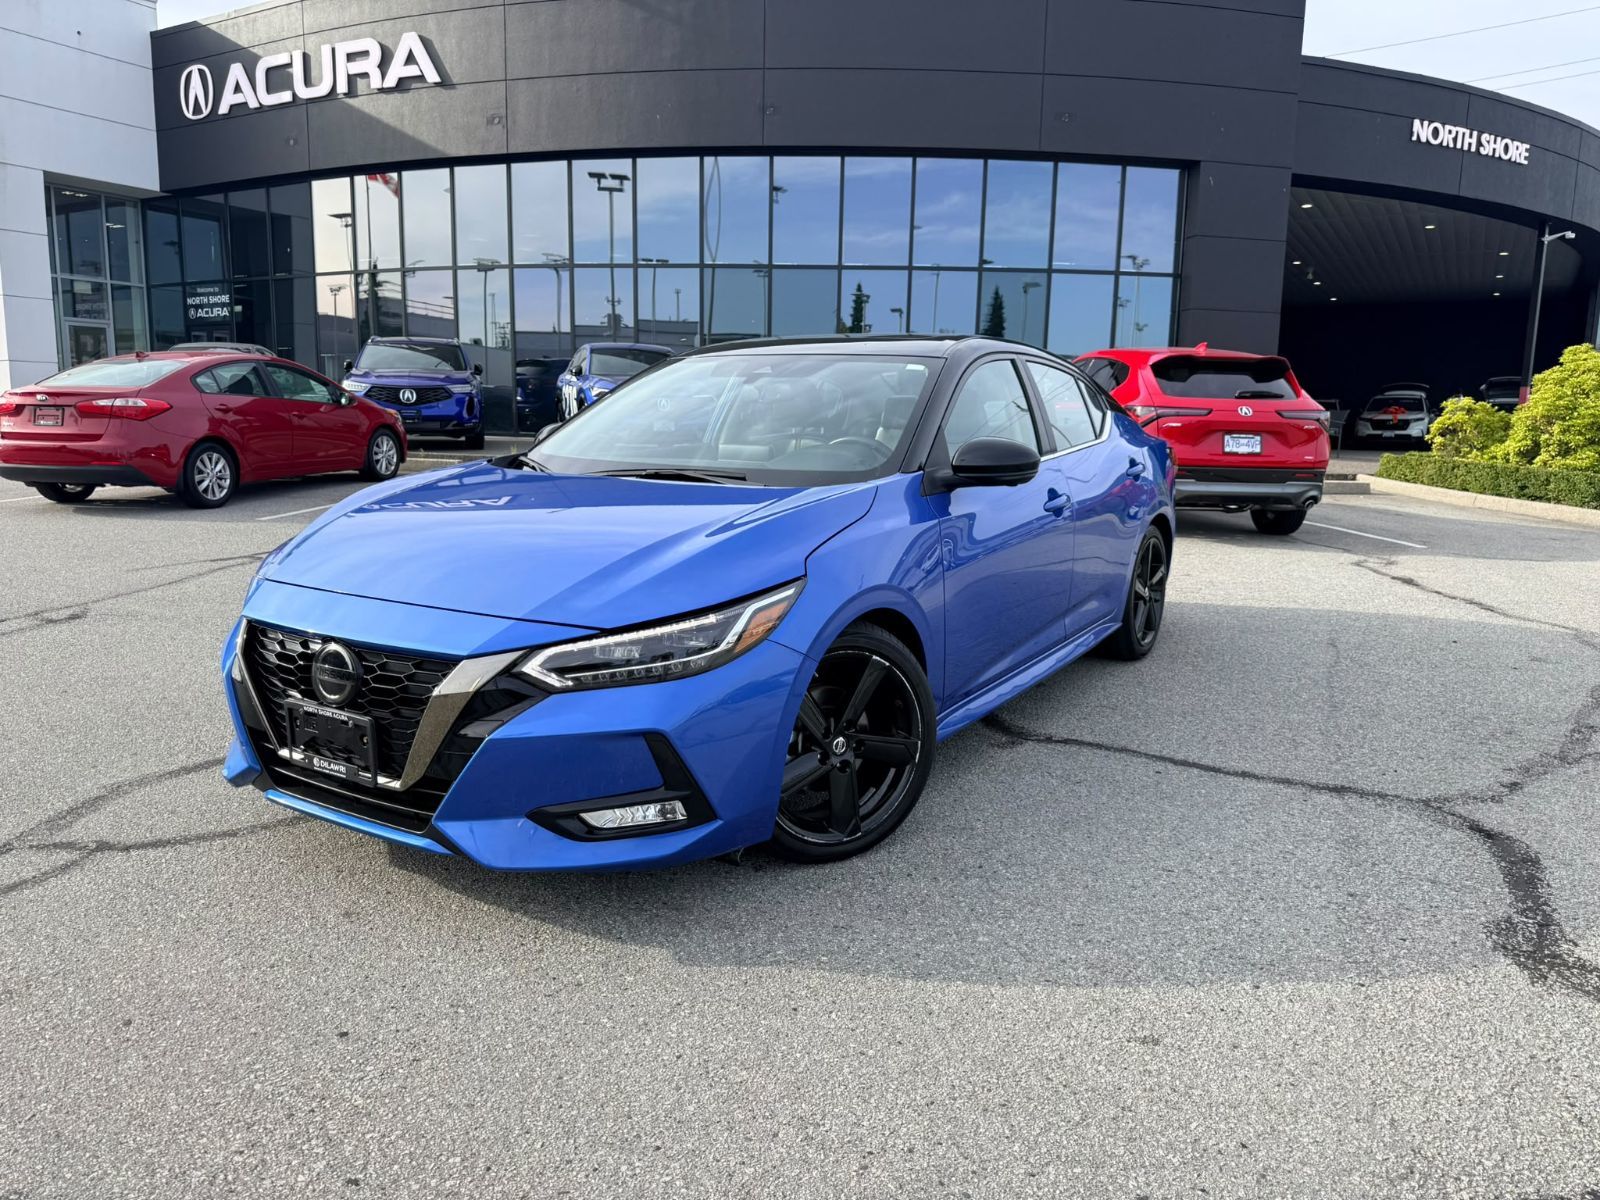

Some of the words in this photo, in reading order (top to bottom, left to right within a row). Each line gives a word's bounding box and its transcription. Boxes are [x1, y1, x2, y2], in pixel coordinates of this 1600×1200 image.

[218, 31, 442, 115] ACURA
[1411, 118, 1478, 152] NORTH
[1479, 133, 1530, 165] SHORE
[187, 296, 208, 305] NORTH
[209, 295, 229, 303] SHORE
[197, 307, 229, 317] ACURA
[303, 706, 318, 714] NORTH
[318, 709, 333, 718] SHORE
[333, 713, 349, 721] ACURA
[320, 760, 346, 773] DILAWRI
